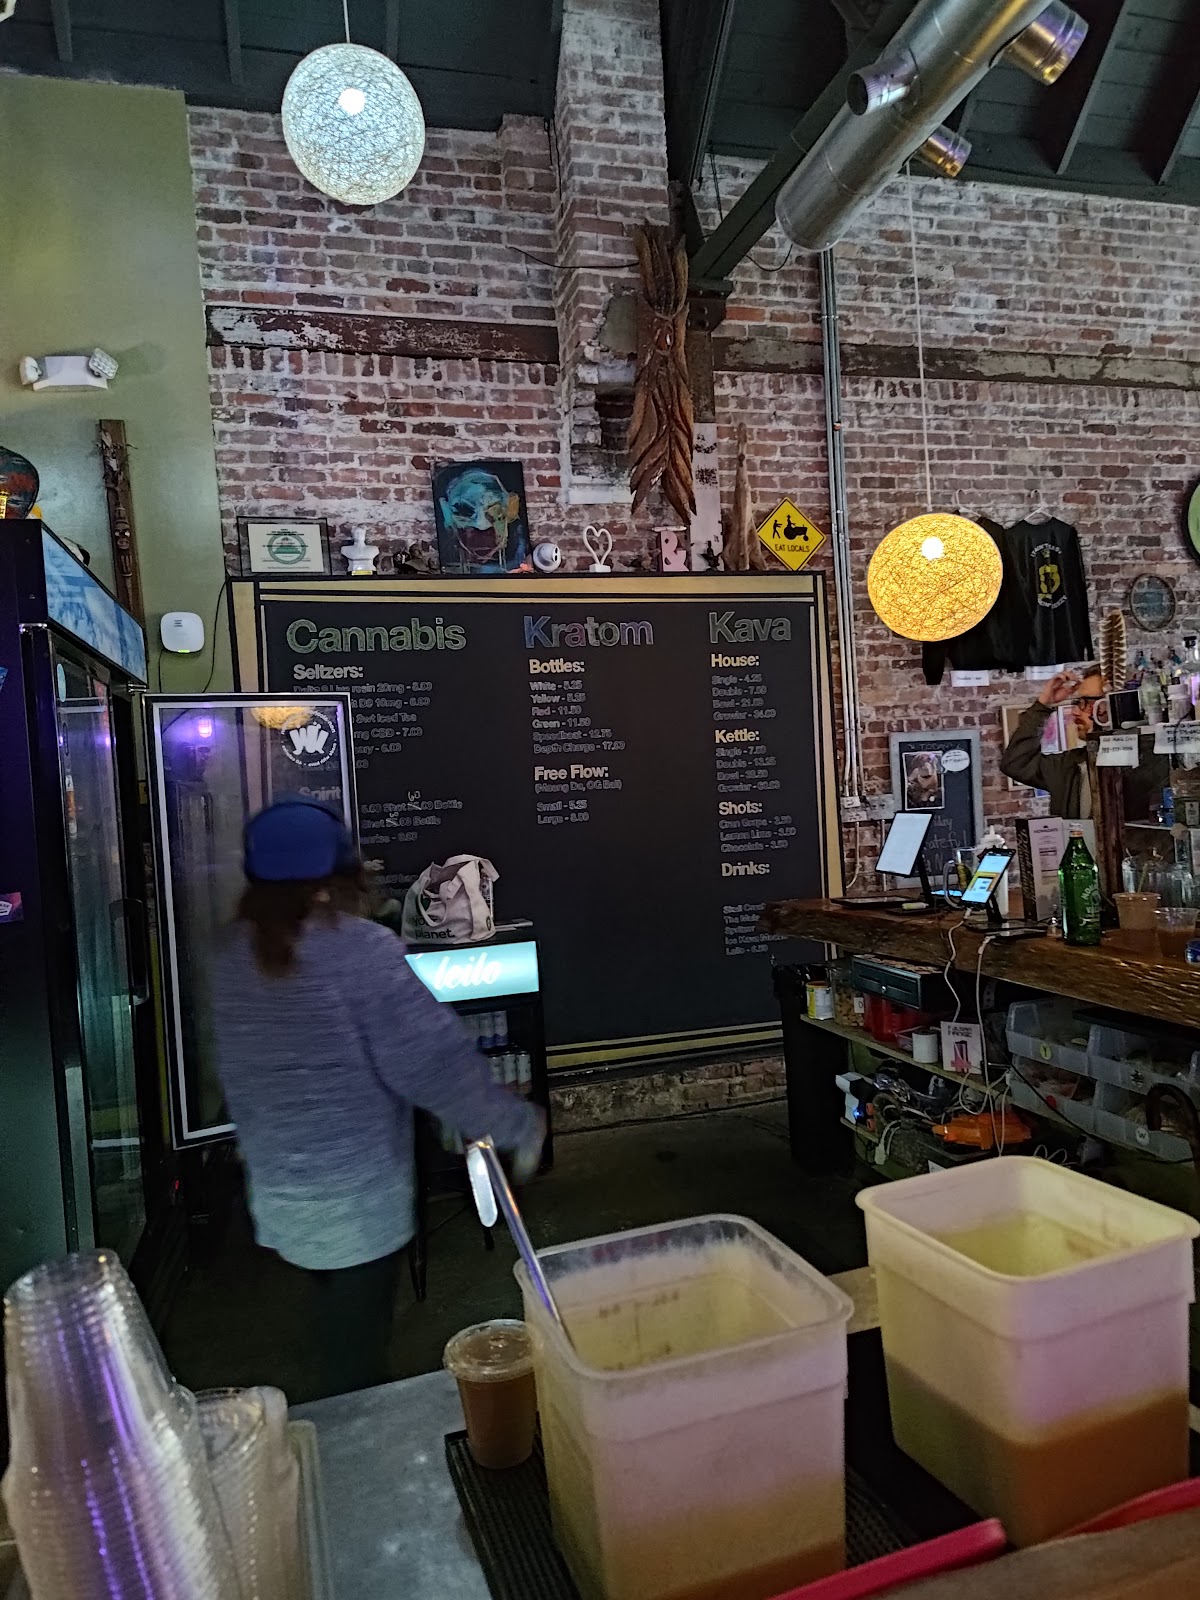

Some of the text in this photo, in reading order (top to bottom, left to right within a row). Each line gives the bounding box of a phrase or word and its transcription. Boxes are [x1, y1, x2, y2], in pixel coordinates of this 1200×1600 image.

[787, 544, 810, 552] LOCALS
[523, 615, 654, 649] Kratom
[709, 611, 792, 644] Kava
[286, 617, 467, 654] Cannabis
[528, 658, 586, 674] Bottles:
[711, 653, 760, 668] House:
[293, 664, 364, 680] Seltzers:
[376, 682, 405, 694] 20mg
[529, 681, 556, 691] White
[530, 693, 560, 705] Yellow
[532, 706, 551, 716] Red
[532, 719, 560, 729] Green
[370, 728, 395, 738] CBD
[715, 728, 760, 743] Kettle:
[534, 744, 562, 755] Depth
[563, 742, 595, 753] Charge
[534, 764, 609, 781] Free Flow:
[537, 801, 562, 812] Small
[568, 800, 587, 810] 5.25
[718, 800, 763, 815] Shots:
[537, 815, 563, 825] Large
[721, 861, 770, 877] Drinks:
[416, 928, 455, 940] planet.
